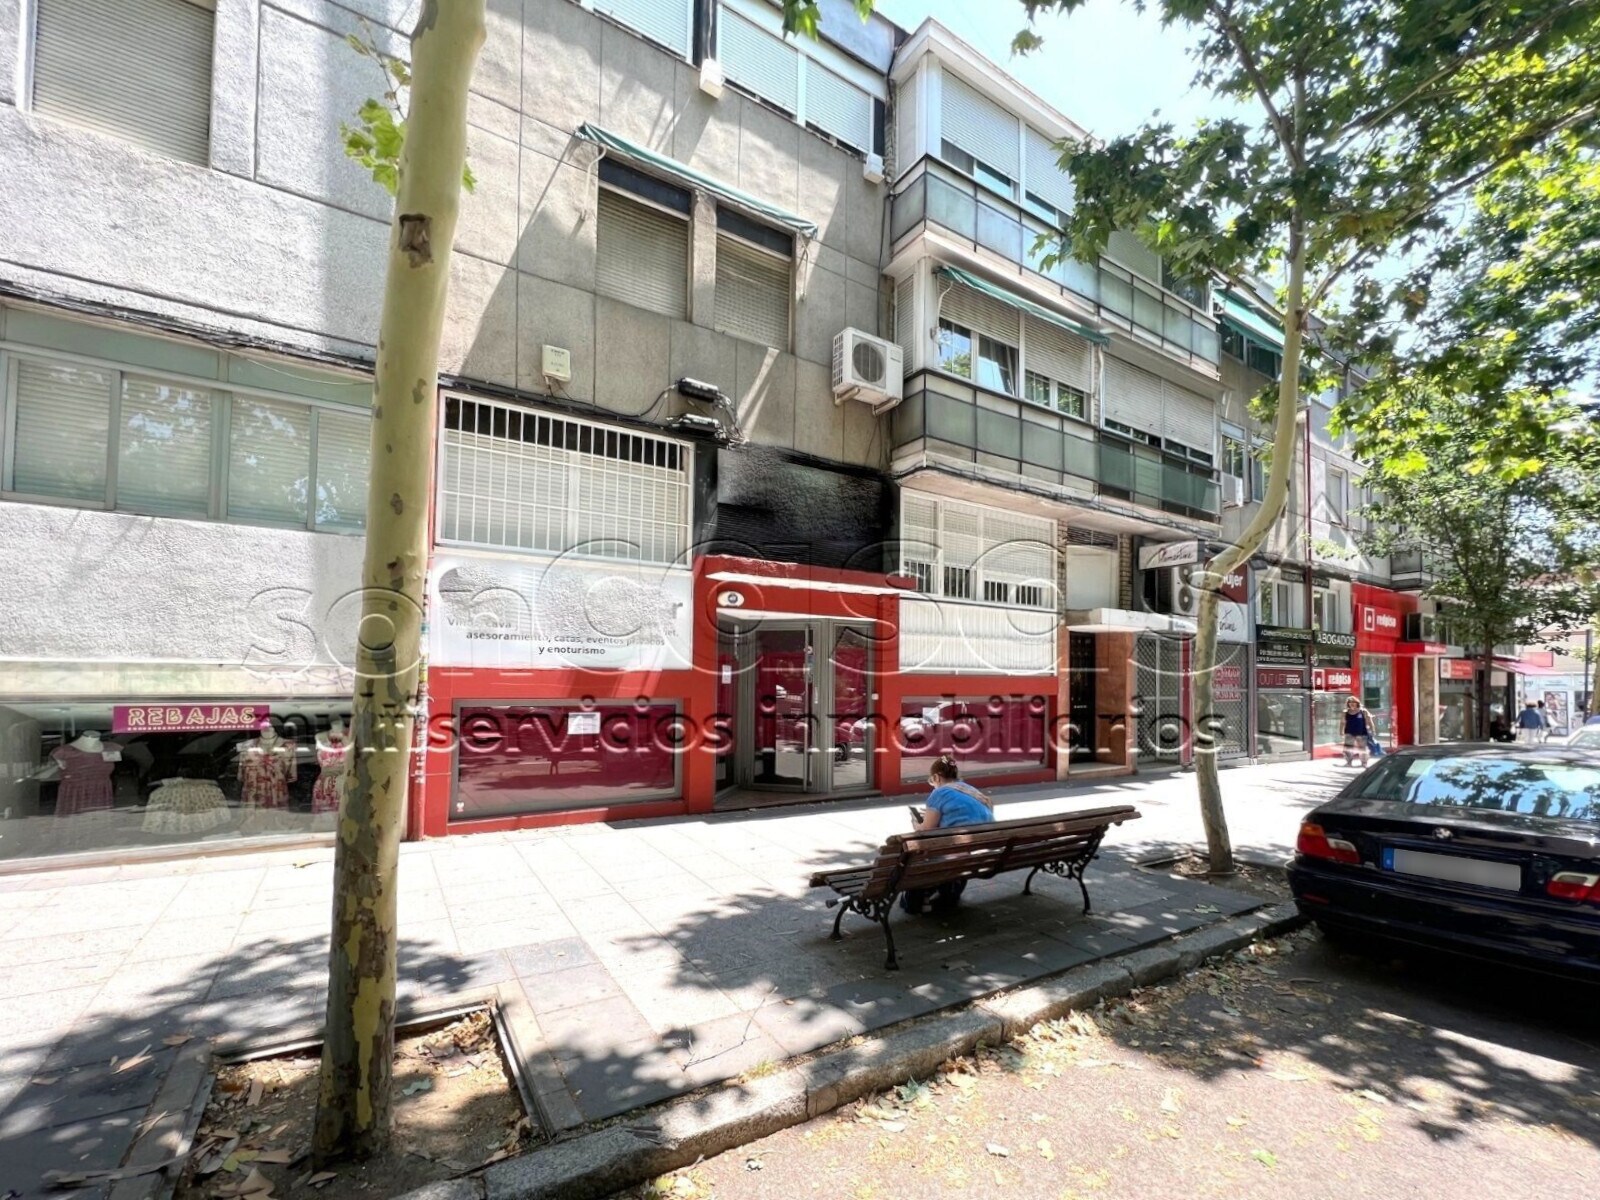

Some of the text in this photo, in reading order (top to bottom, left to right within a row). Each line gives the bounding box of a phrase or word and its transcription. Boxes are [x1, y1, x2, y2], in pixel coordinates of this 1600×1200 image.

[466, 631, 551, 643] asesoramiento,
[554, 635, 583, 645] catas,
[586, 636, 624, 645] eventos
[1317, 633, 1355, 647] ABOGADOS
[539, 646, 606, 655] y enoturismo
[128, 706, 256, 727] REBAJAS
